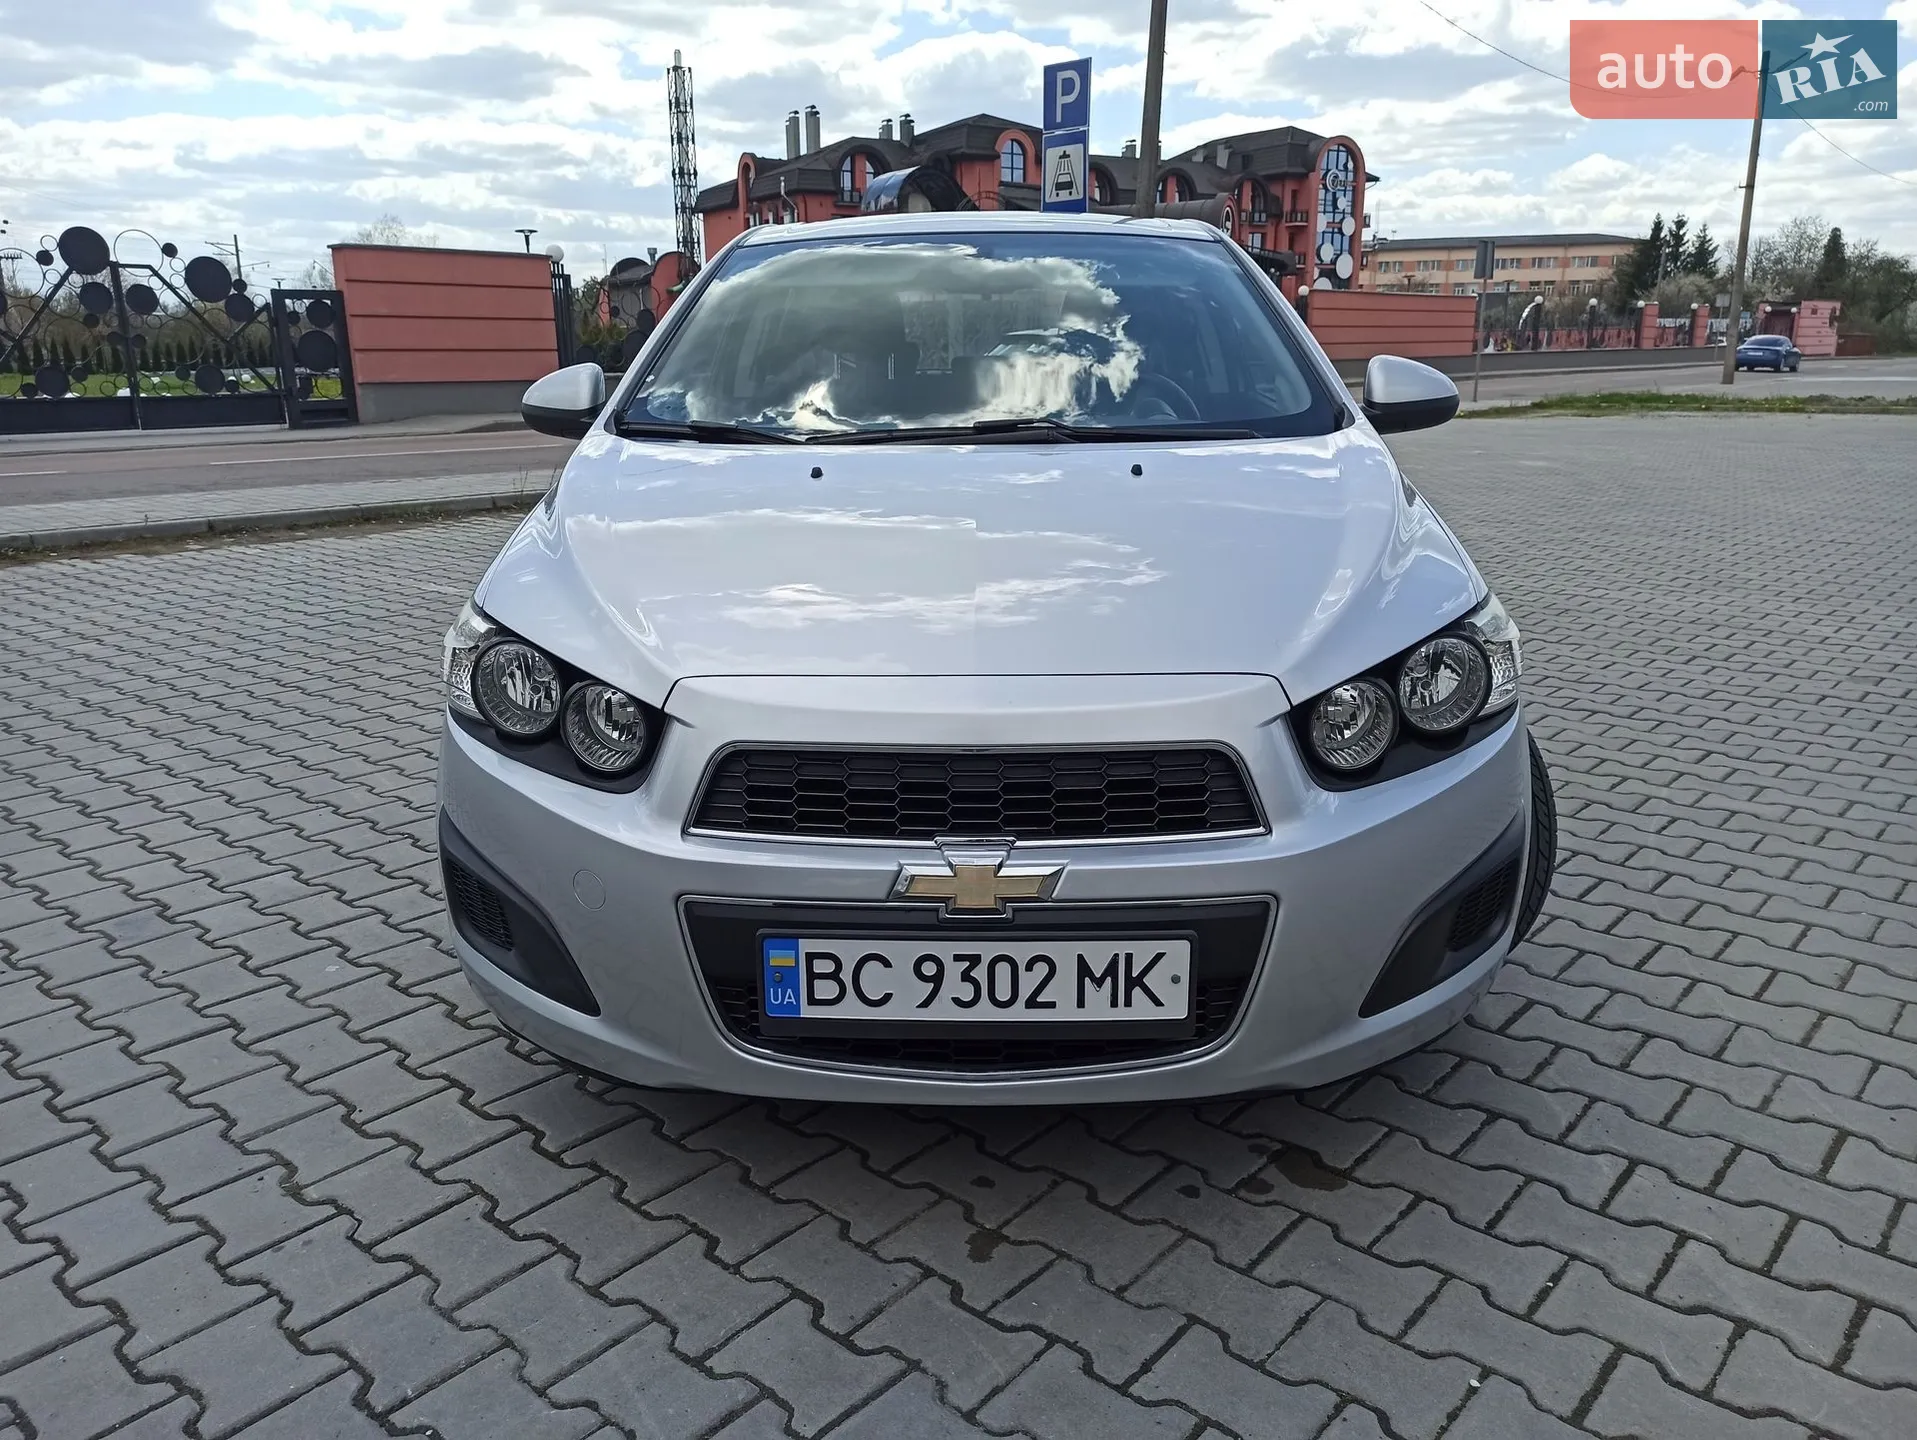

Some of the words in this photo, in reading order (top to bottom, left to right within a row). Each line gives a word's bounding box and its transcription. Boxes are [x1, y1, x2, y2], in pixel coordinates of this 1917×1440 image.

[1055, 69, 1081, 123] P
[770, 988, 796, 1005] UA
[804, 952, 894, 1008] BC
[912, 953, 1057, 1009] 9302
[1076, 952, 1167, 1009] MK
